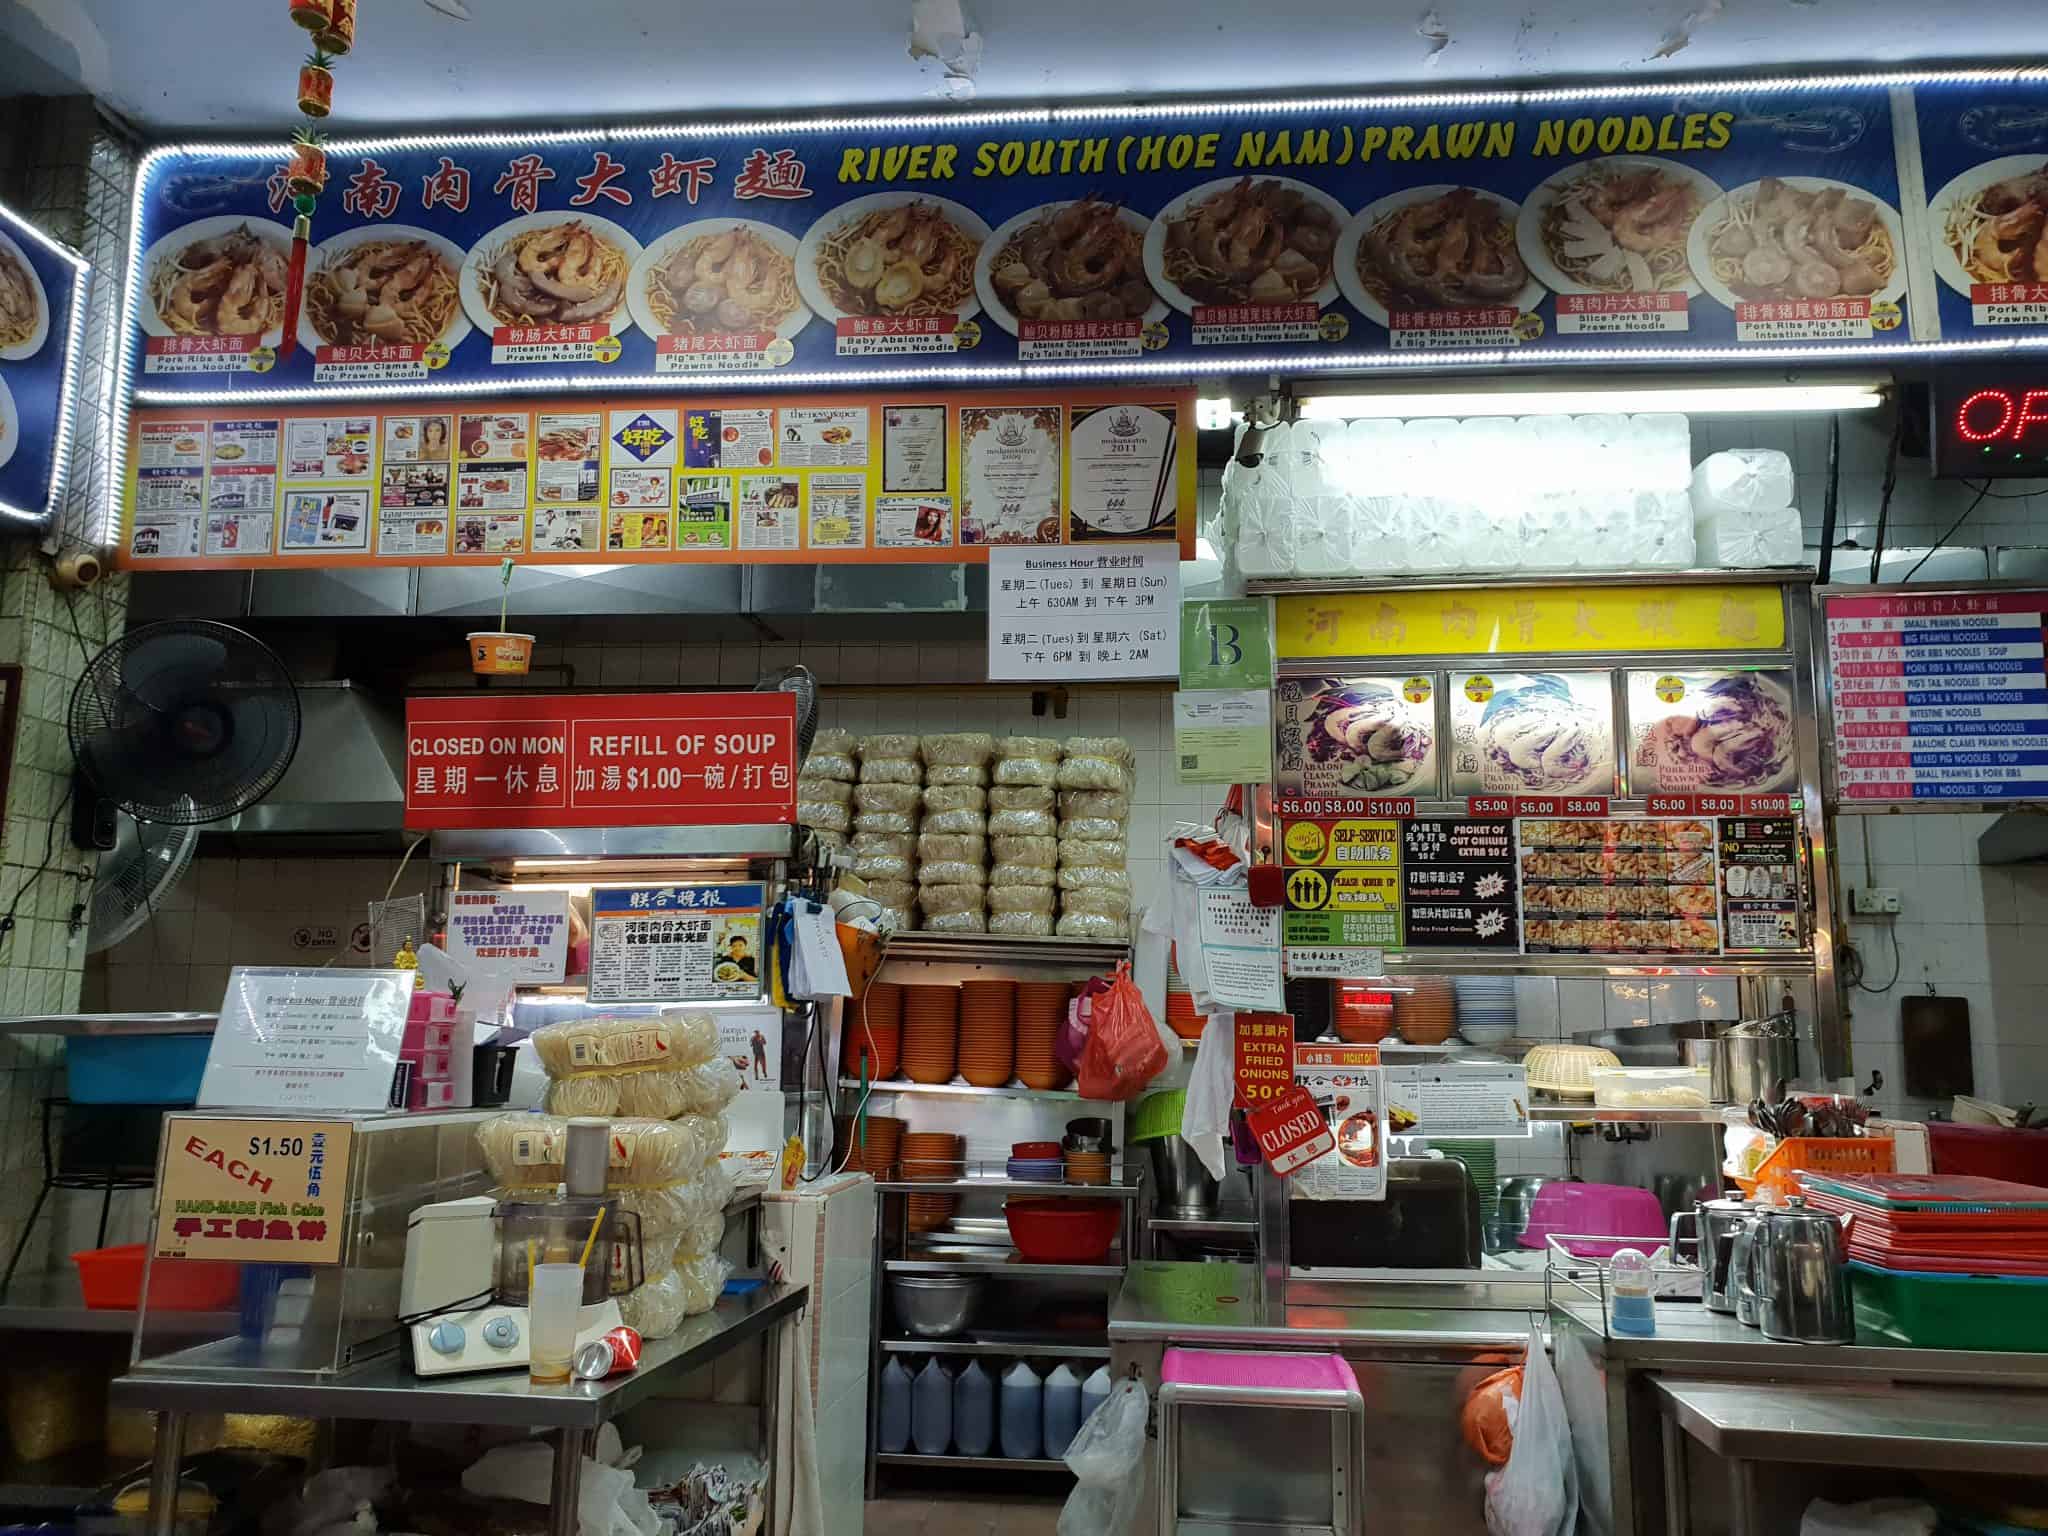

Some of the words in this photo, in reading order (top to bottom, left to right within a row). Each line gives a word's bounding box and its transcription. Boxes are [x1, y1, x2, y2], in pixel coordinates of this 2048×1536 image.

[838, 144, 956, 183] RIVER
[1532, 111, 1735, 158] NOODLES
[510, 325, 593, 342] 粉肠大虾面
[622, 428, 666, 447] 好吃
[1025, 558, 1068, 569] Business
[1070, 559, 1094, 569] Hour
[1082, 578, 1094, 590] 到
[1016, 597, 1041, 609] 上午
[1047, 596, 1079, 608] 630AM
[1084, 596, 1097, 608] 到
[1104, 595, 1128, 607] 下午
[1135, 594, 1154, 606] 3PM
[1077, 632, 1089, 644] 到
[1208, 624, 1242, 666] B
[1021, 651, 1046, 663] 下午
[1053, 651, 1072, 662] 6PM
[1079, 650, 1091, 663] 到
[1097, 649, 1122, 661] 晚上
[1129, 648, 1149, 661] 2AM
[410, 738, 484, 757] CLOSED
[489, 738, 516, 755] ON
[522, 736, 564, 754] MON
[589, 735, 667, 756] REFILL
[676, 735, 706, 754] OF
[714, 733, 777, 754] SOUP
[415, 765, 560, 795] 星期一休息
[1282, 801, 1320, 814] $6.00
[1325, 800, 1363, 813] $8.00
[1370, 801, 1411, 815] $10.00
[1475, 800, 1507, 812] $5.00
[1521, 802, 1553, 813] $6.00
[1567, 801, 1600, 812] $8.00
[1652, 799, 1685, 811] $6.00
[1701, 799, 1734, 810] $8.00
[1750, 799, 1785, 810] $10.00
[1334, 829, 1396, 842] SELF-SERVICE
[624, 920, 711, 934] 河南肉骨大虾面
[1243, 1042, 1285, 1053] EXTRA
[1245, 1056, 1283, 1066] FRIED
[1239, 1068, 1289, 1080] ONIONS
[1262, 1110, 1320, 1153] CLOSED
[248, 1137, 303, 1156] $1.50
[184, 1136, 273, 1194] EACH
[306, 1132, 326, 1197] 壹元伍角
